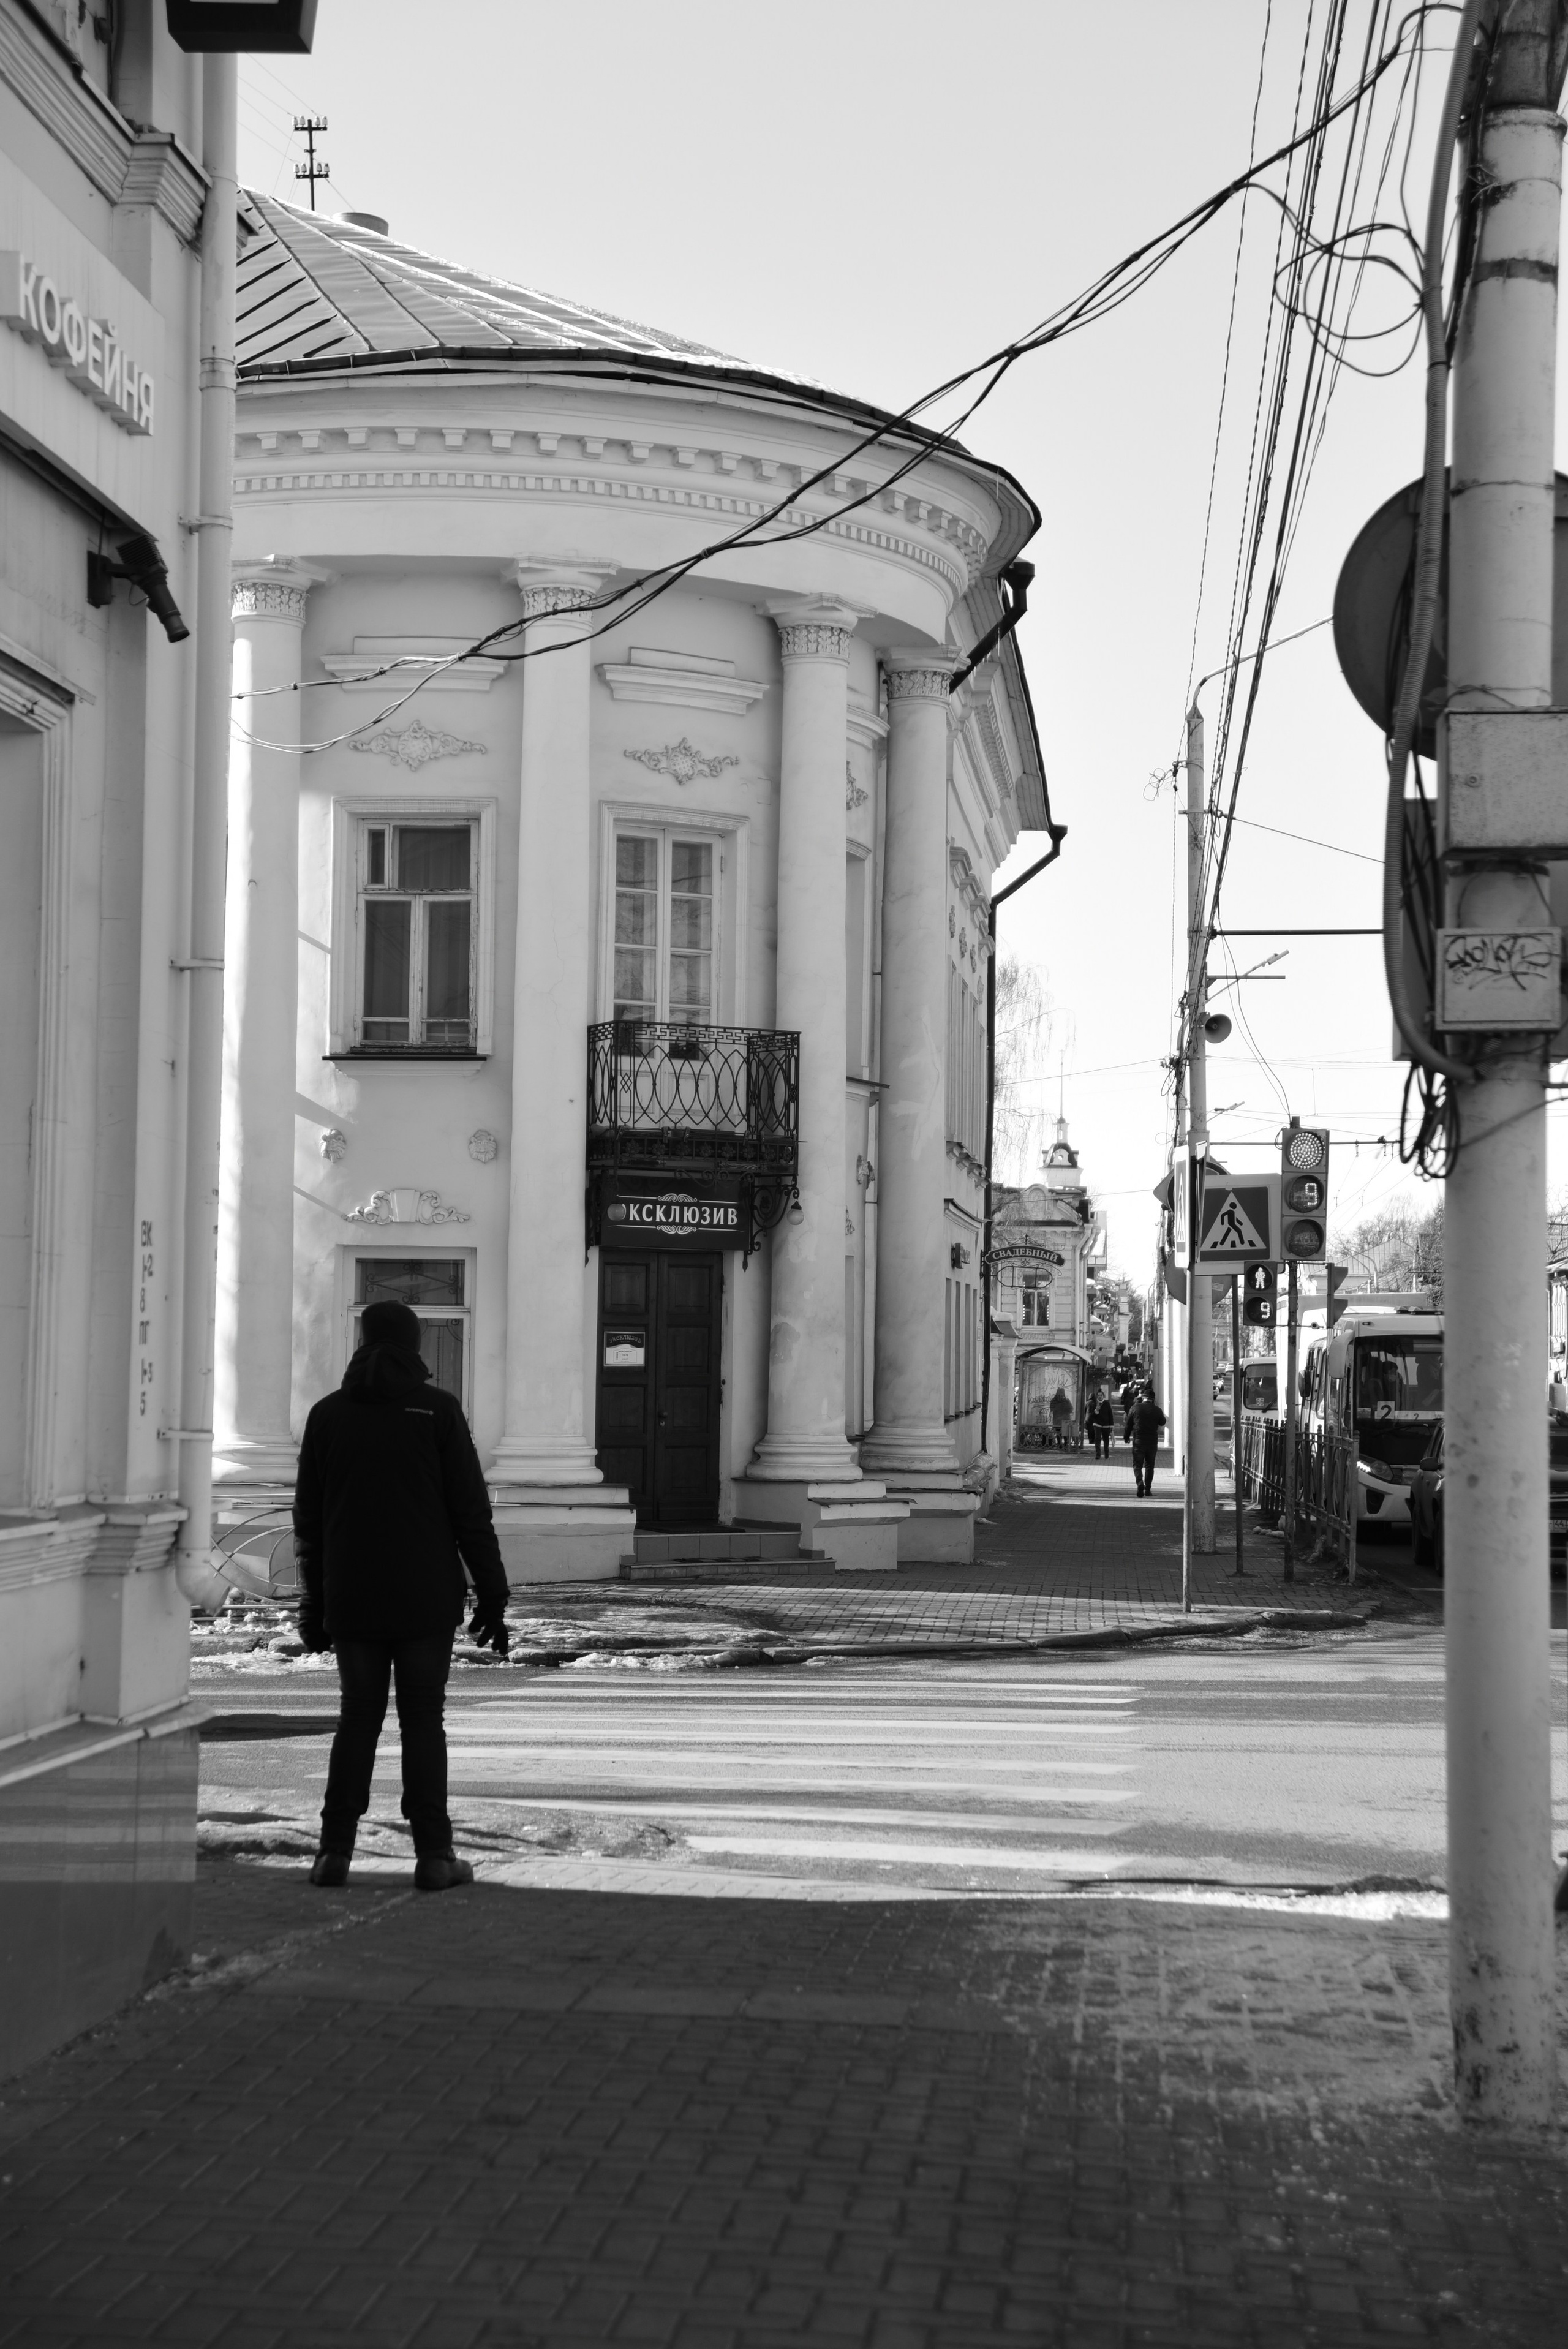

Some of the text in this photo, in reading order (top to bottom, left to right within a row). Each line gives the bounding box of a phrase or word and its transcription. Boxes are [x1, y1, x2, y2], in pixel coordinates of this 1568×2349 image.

[20, 252, 154, 435] КОФЕЙНЯ
[1305, 1183, 1317, 1206] 9
[621, 1204, 738, 1225] КСКЛЮЗИВ
[992, 1248, 1059, 1262] СВАДЕБНЫЙ
[1261, 1302, 1270, 1319] 9
[1380, 1404, 1392, 1421] 2
